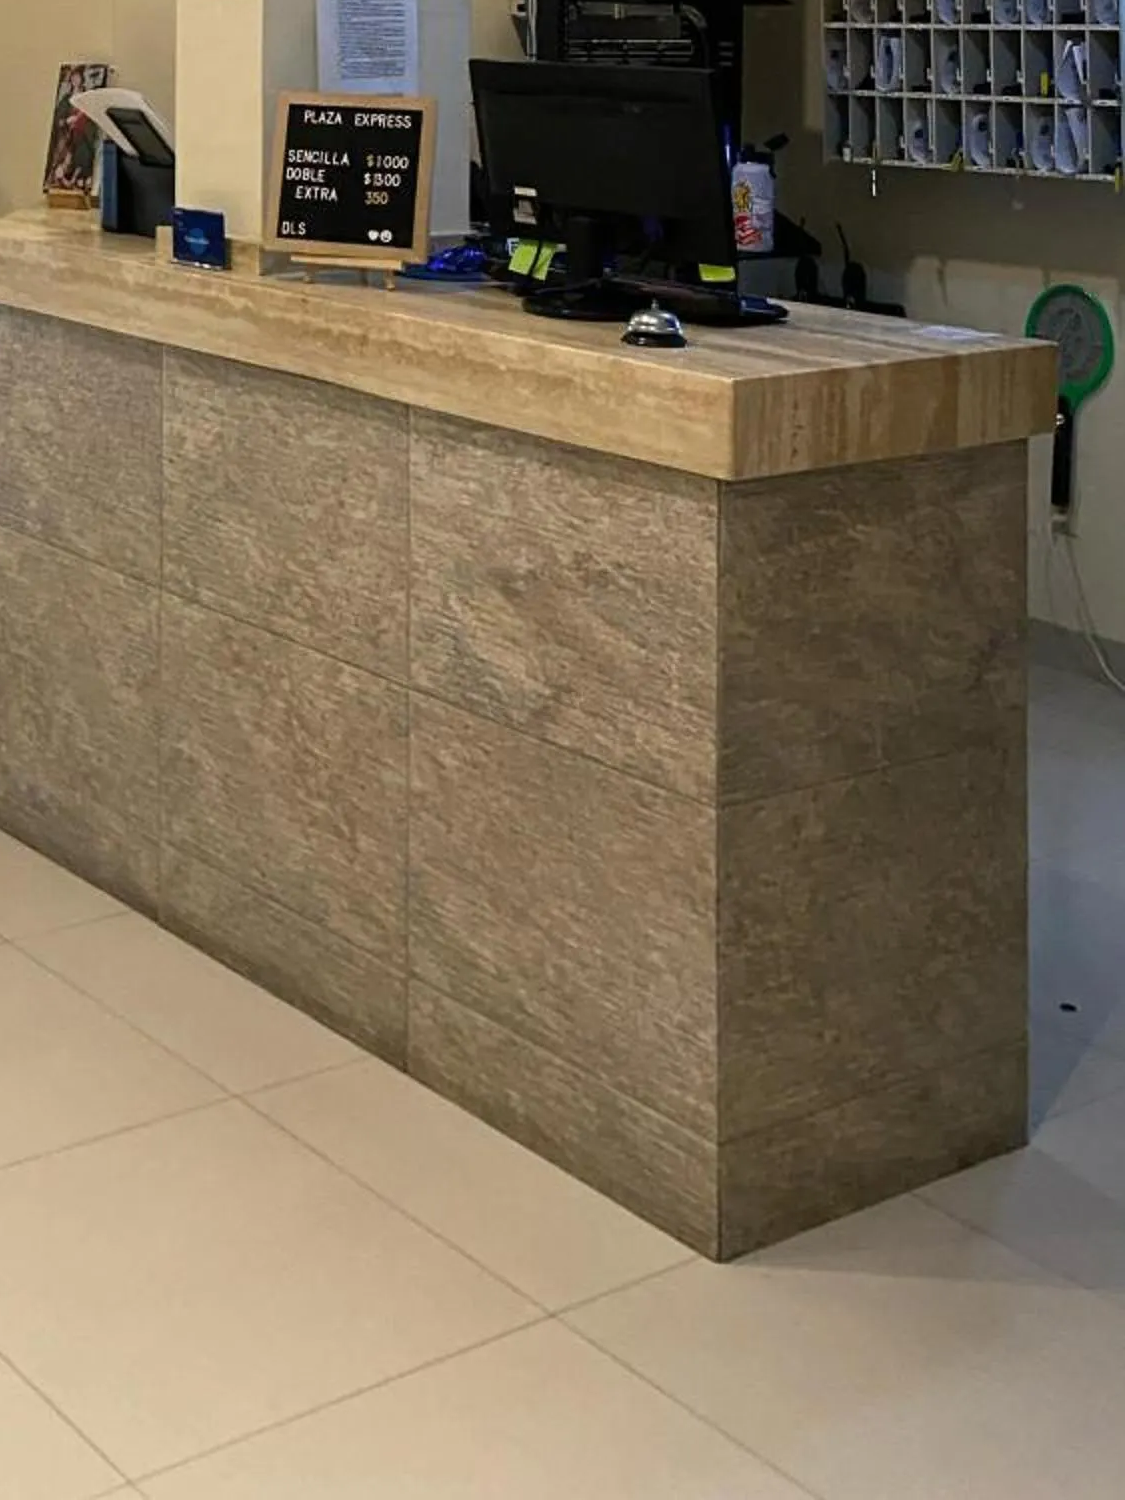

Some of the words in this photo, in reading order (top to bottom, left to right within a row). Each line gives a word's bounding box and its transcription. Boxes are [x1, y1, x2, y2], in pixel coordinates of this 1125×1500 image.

[303, 110, 342, 125] PLAZA
[354, 113, 412, 129] EXPRESS
[288, 150, 350, 166] SENCILLA
[286, 167, 326, 183] DOBLE
[295, 186, 338, 201] EXTRA
[364, 191, 389, 205] 350
[281, 221, 307, 236] DLS
